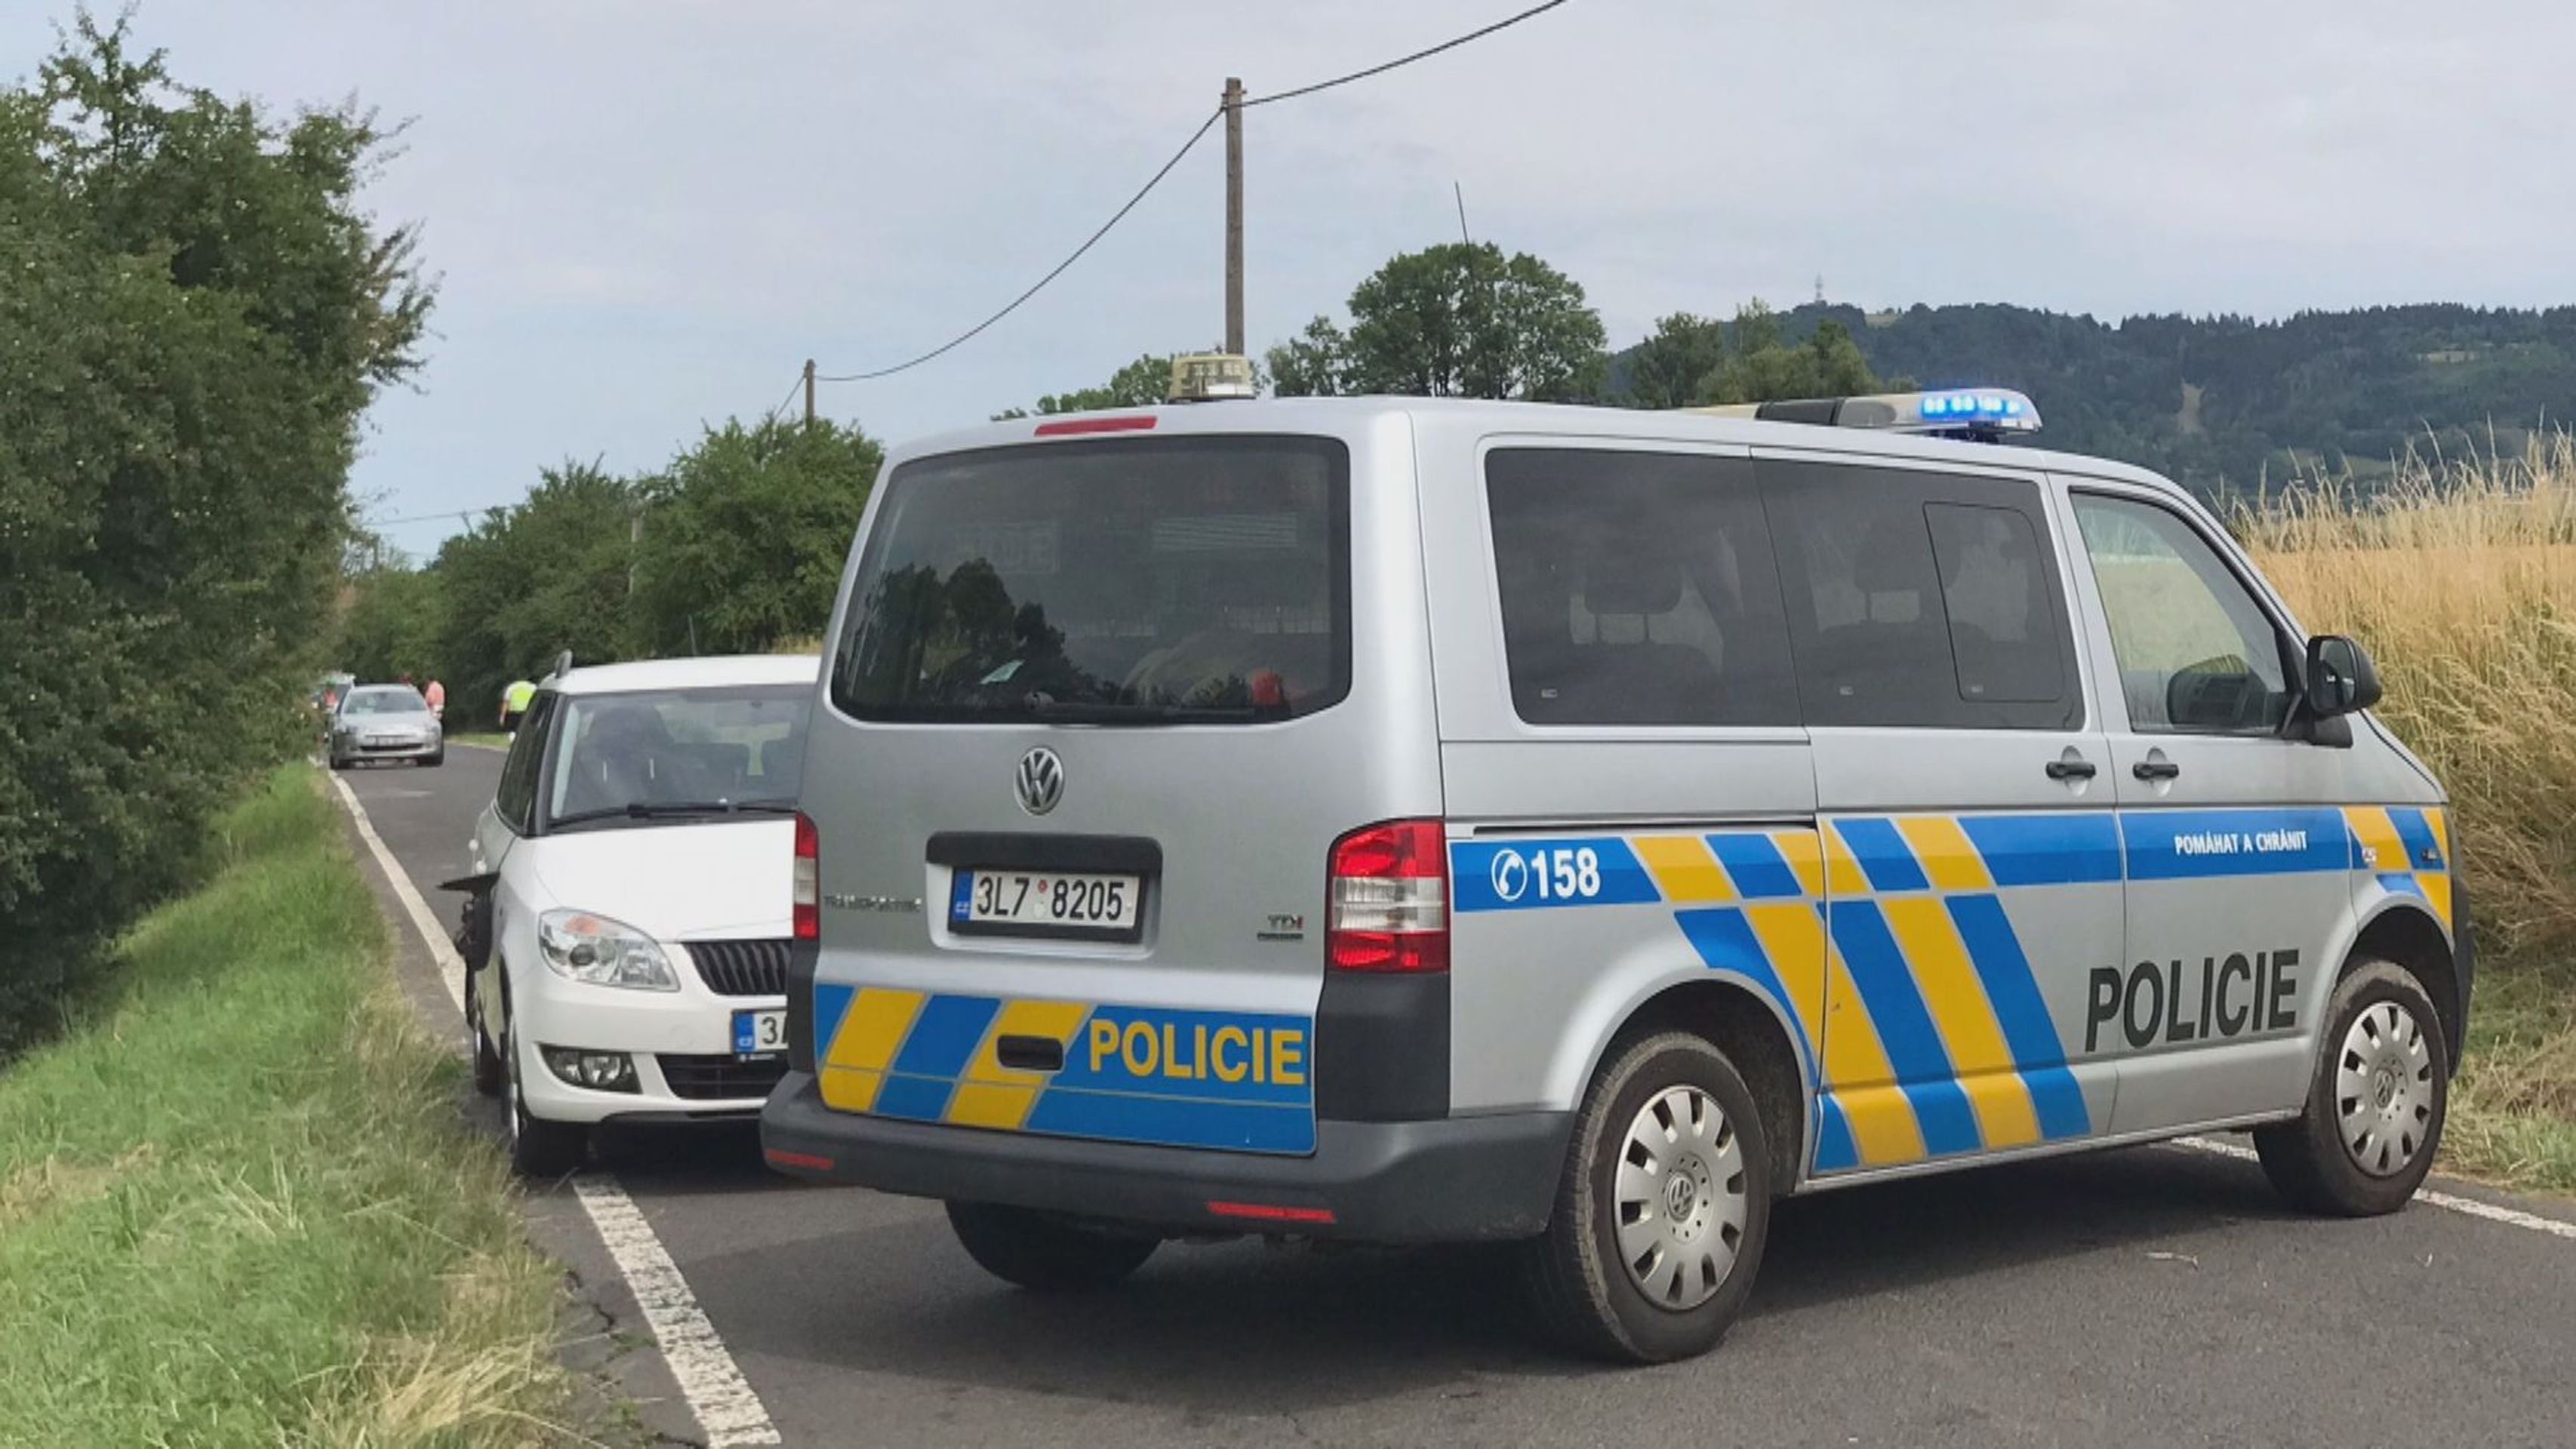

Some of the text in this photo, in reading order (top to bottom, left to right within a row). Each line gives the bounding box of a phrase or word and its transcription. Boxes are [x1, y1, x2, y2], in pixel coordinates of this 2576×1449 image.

[2174, 829, 2307, 856] POMÁHAT A CHRÁNIT
[977, 876, 1125, 921] 3L7 8205
[1531, 847, 1601, 899] 158
[2085, 949, 2299, 1053] POLICIE
[1090, 1019, 1305, 1085] POLICIE
